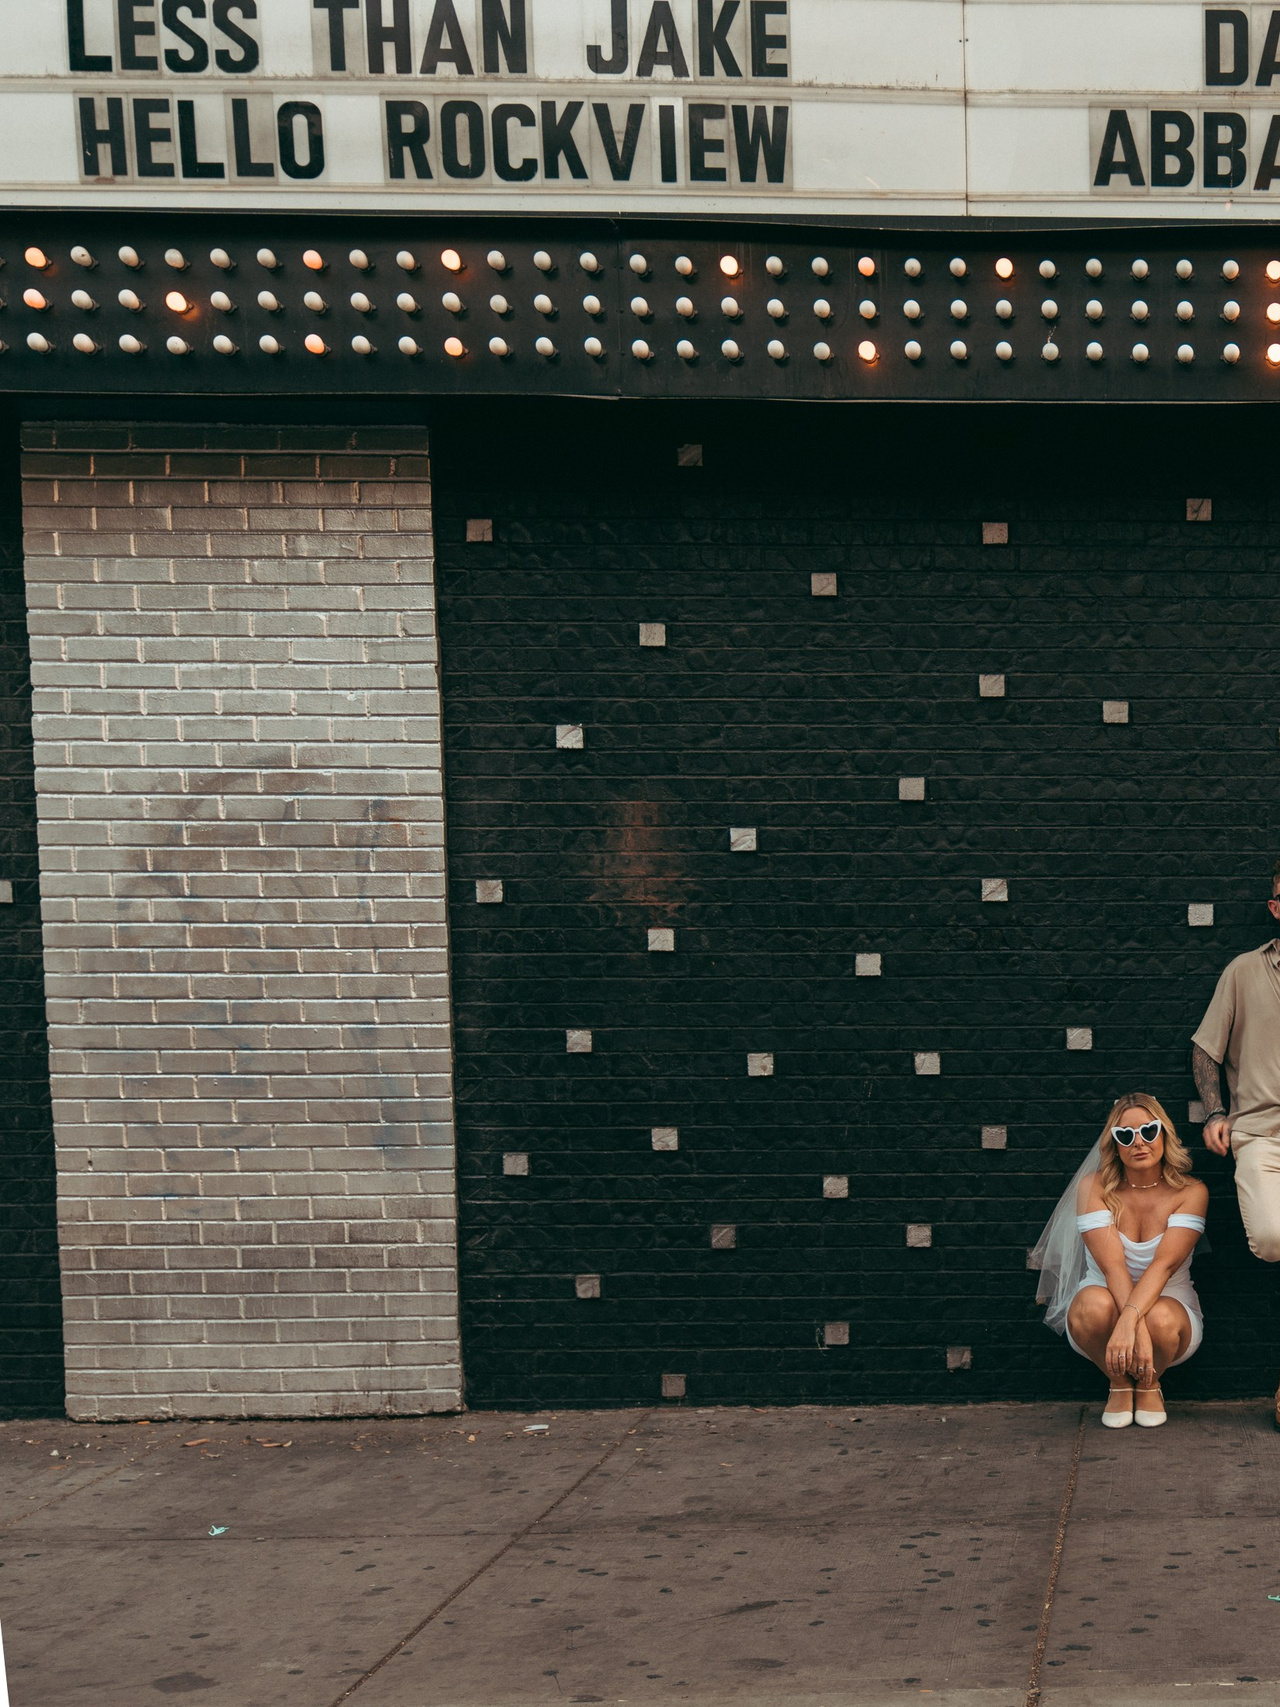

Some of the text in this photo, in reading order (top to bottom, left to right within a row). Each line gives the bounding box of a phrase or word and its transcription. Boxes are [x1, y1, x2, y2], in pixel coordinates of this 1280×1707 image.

[69, 0, 787, 78] LESS THAN JAKE
[79, 97, 789, 183] HELLO ROCKVIEW
